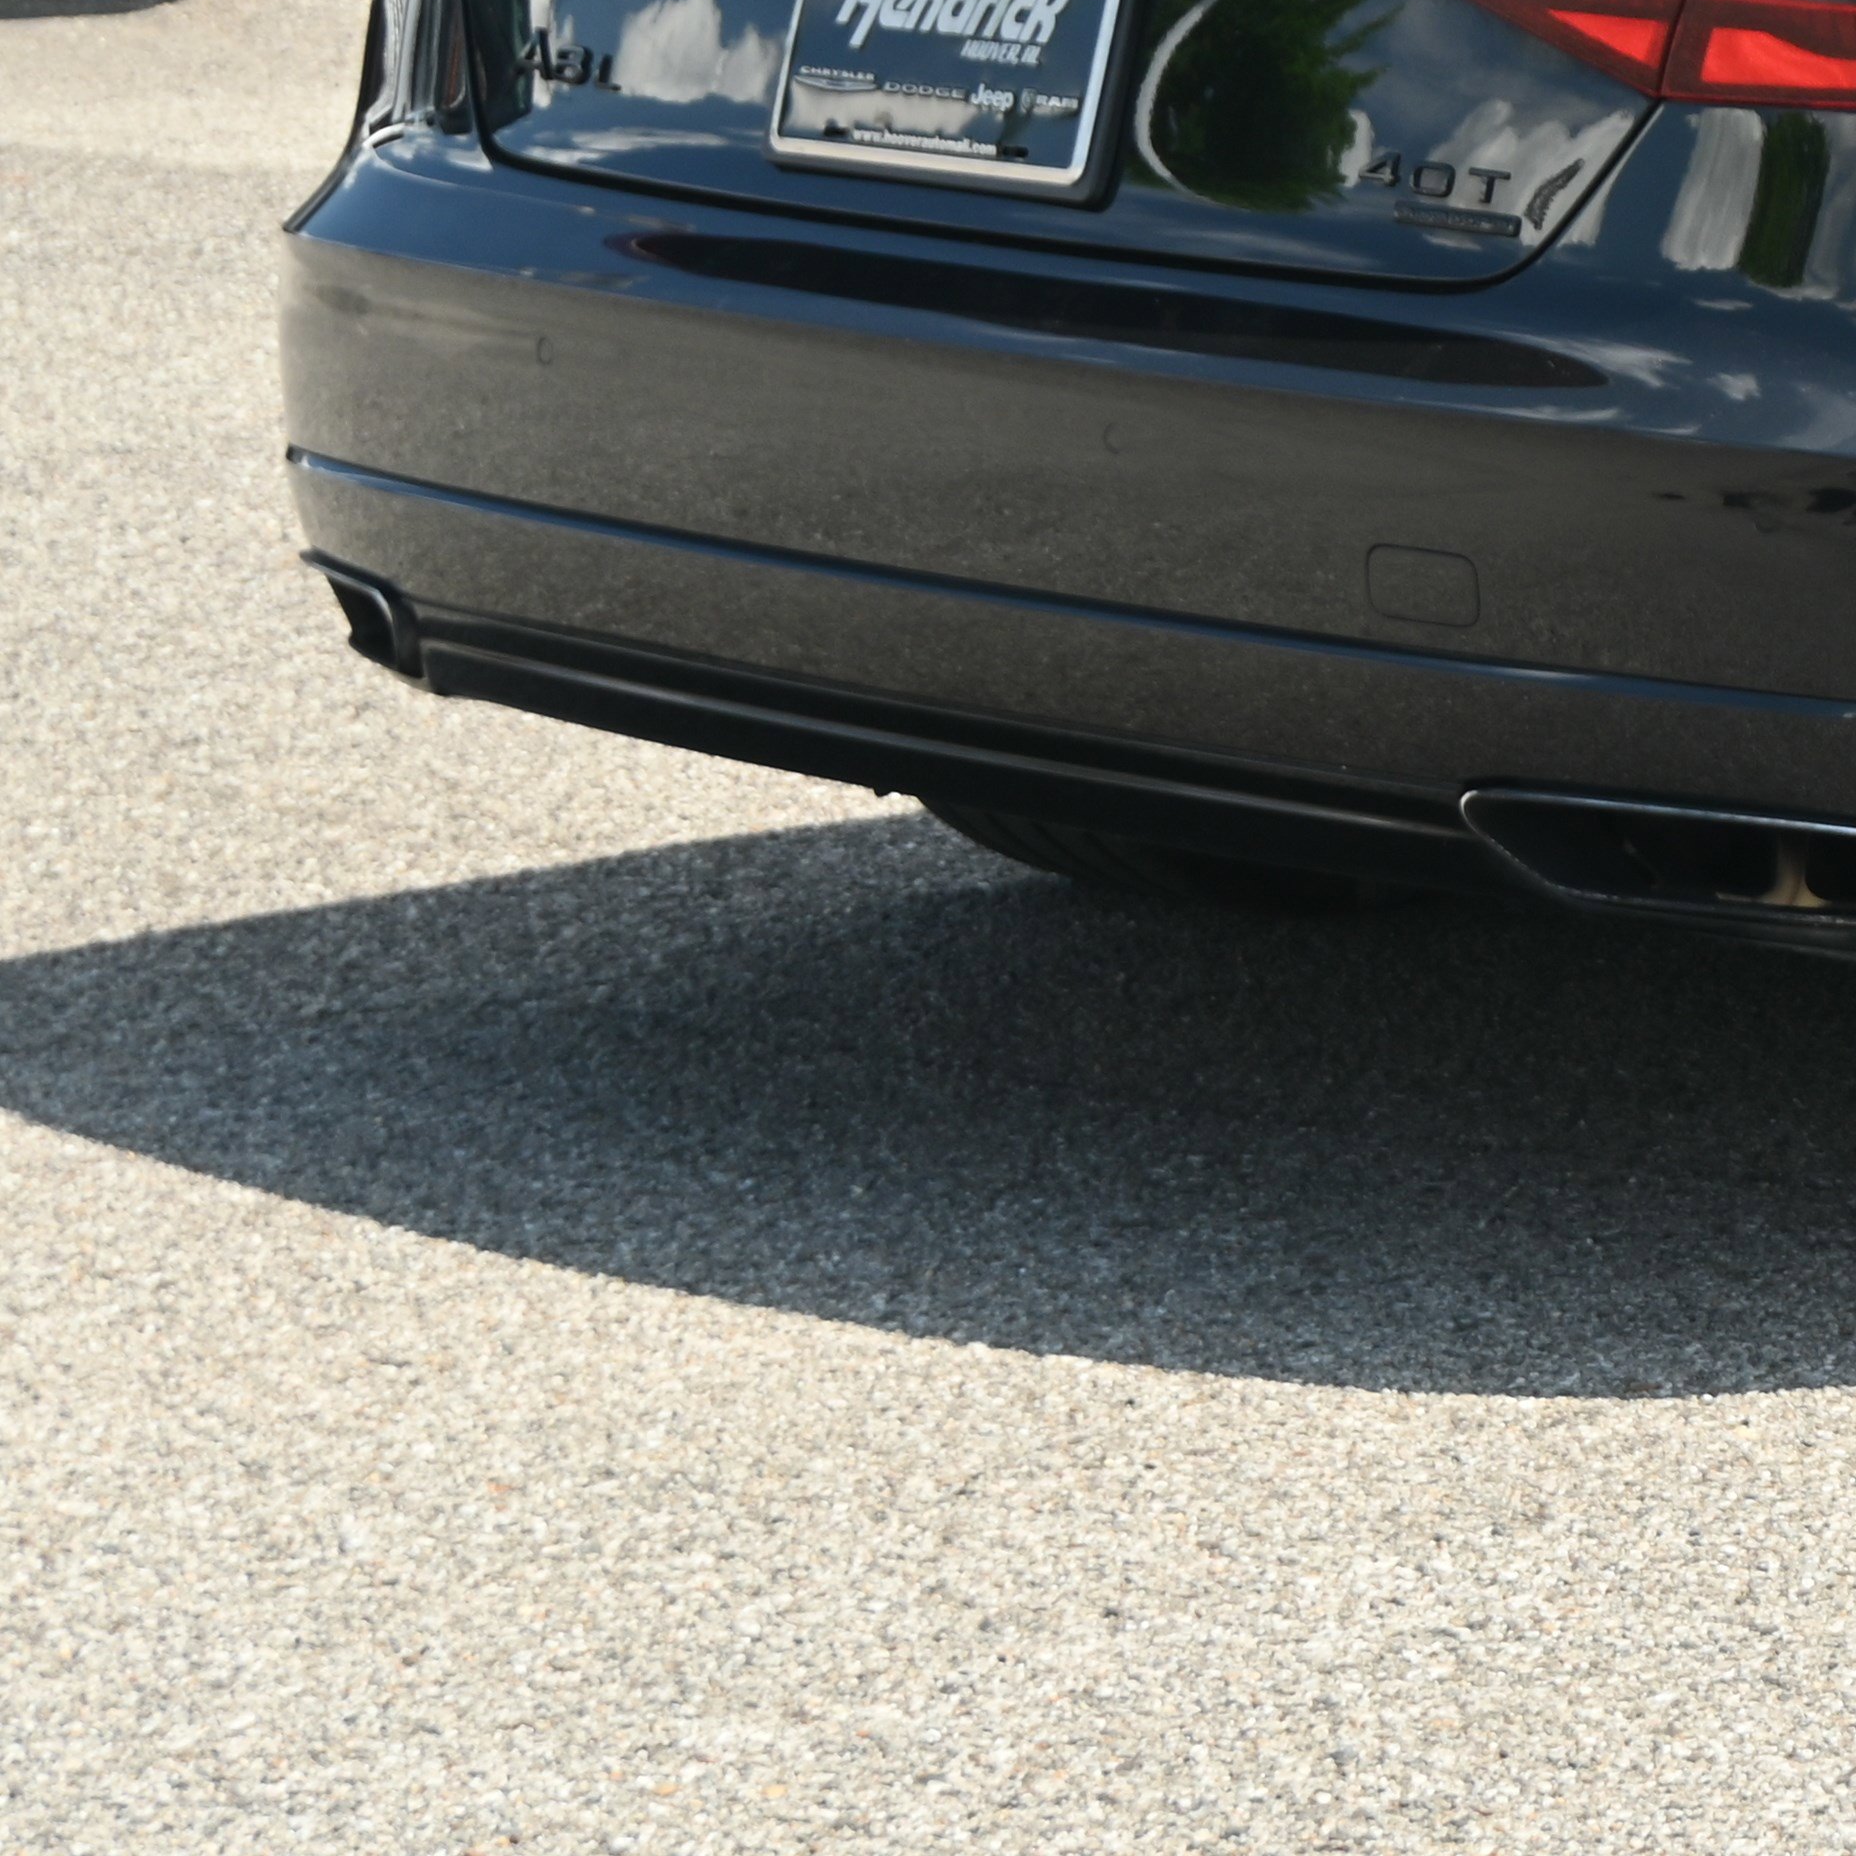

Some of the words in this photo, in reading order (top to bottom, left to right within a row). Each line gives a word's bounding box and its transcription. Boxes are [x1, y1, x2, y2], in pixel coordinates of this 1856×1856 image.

[799, 64, 875, 81] CHRYSLER
[883, 81, 967, 101] DODGE
[970, 83, 1015, 112] Jeep
[1035, 94, 1079, 109] RAM
